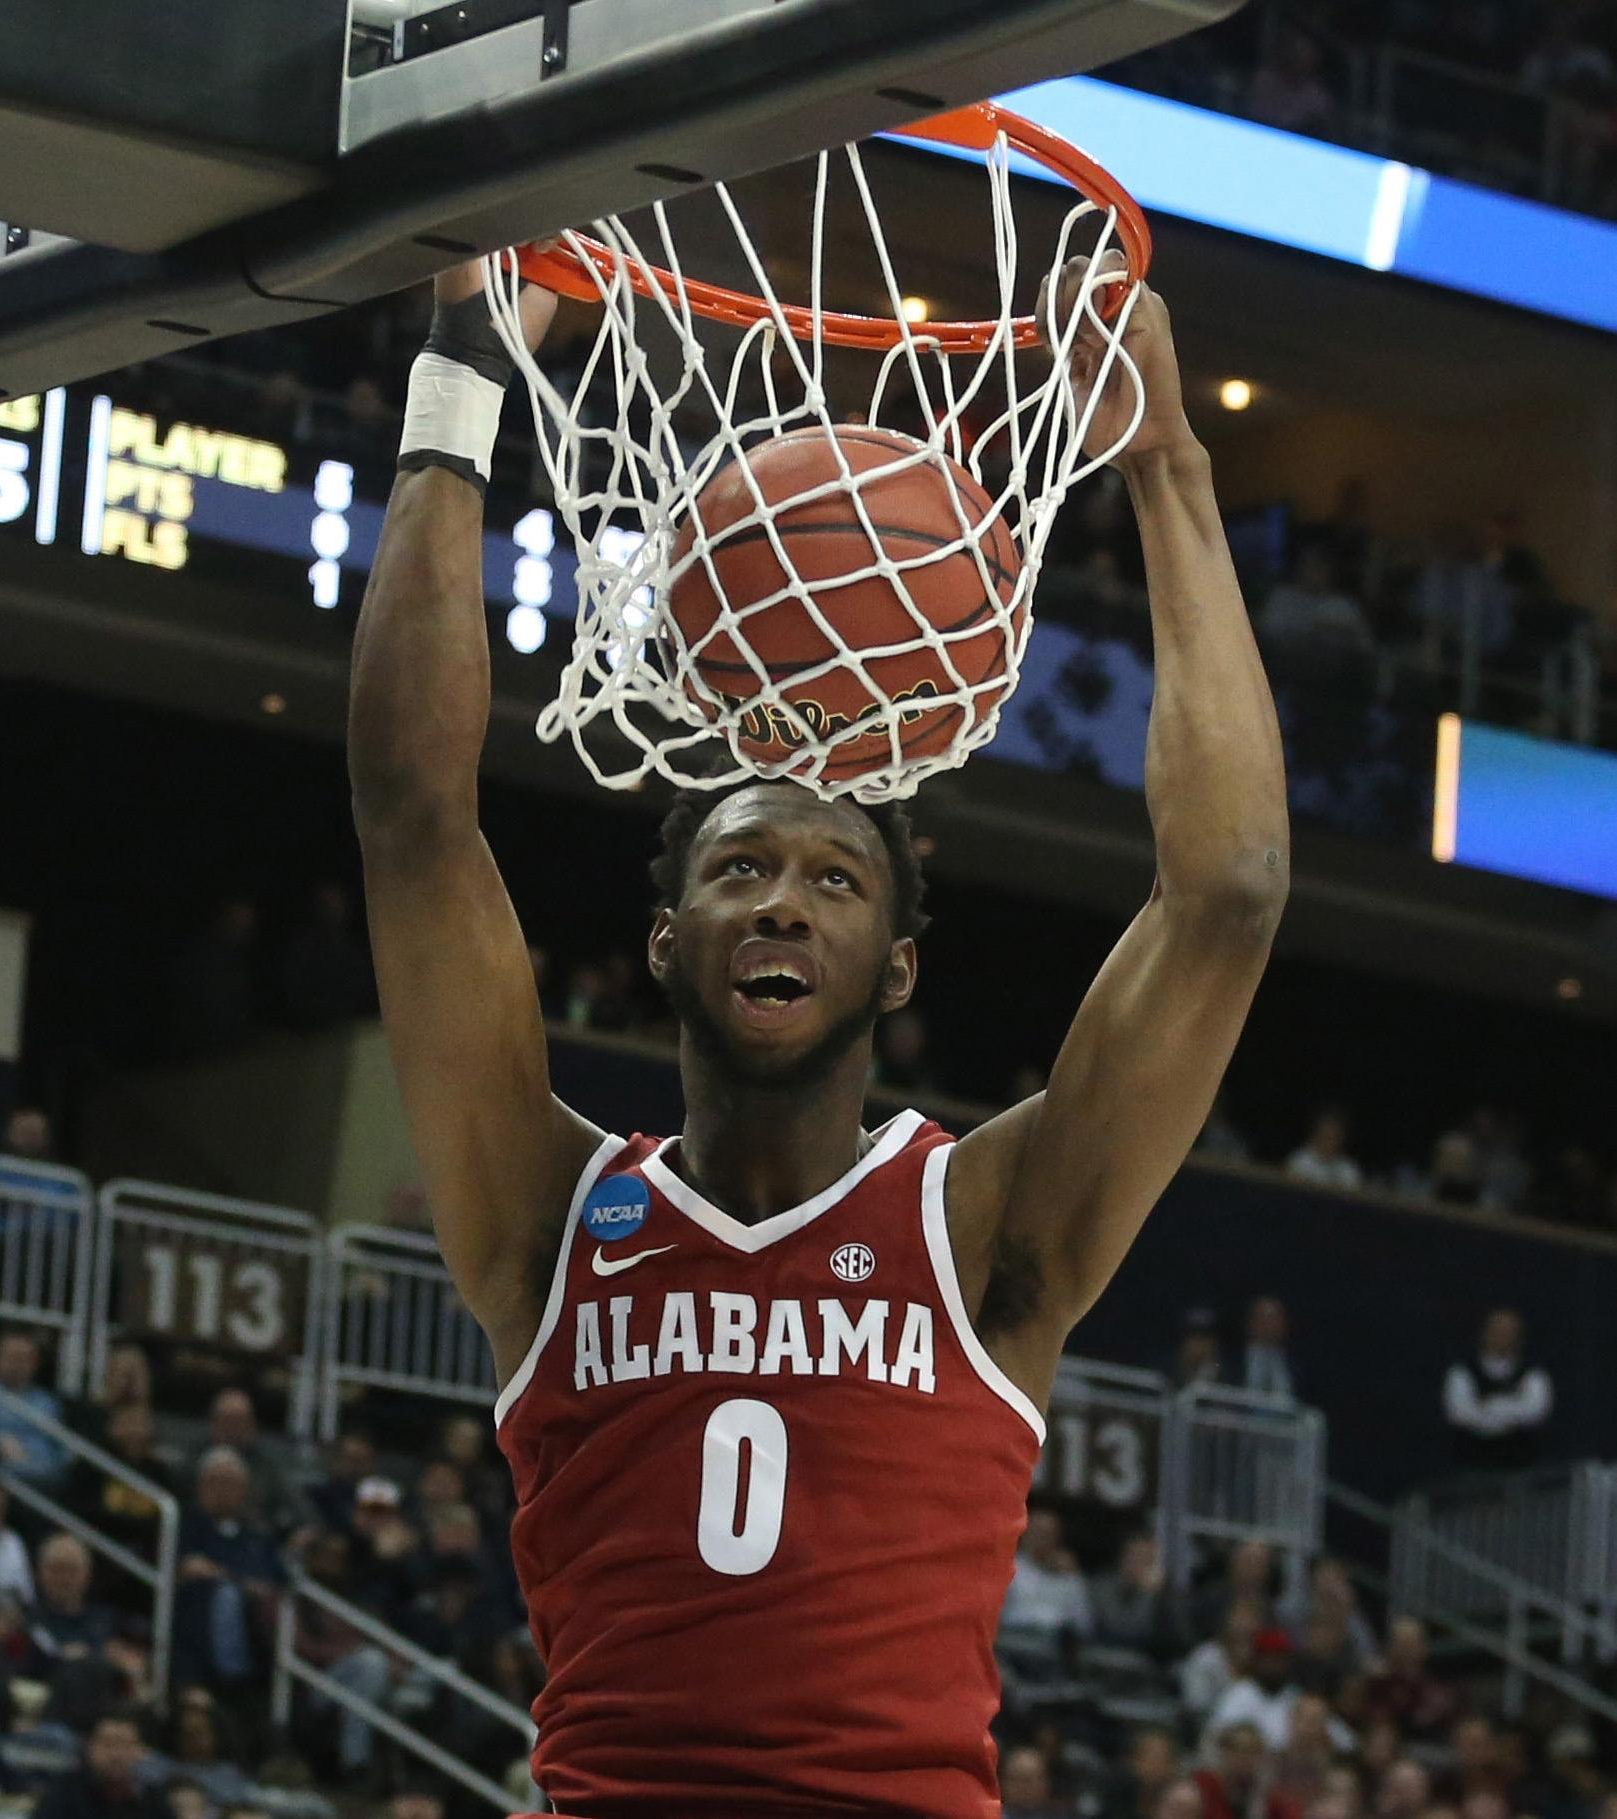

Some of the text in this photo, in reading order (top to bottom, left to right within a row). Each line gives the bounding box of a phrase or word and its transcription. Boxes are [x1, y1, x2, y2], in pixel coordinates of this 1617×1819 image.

[105, 458, 194, 522] PTS
[108, 407, 287, 493] PLAYER
[98, 507, 190, 570] FLS
[590, 1204, 646, 1224] NCAA
[143, 1247, 282, 1350] 113
[835, 1247, 871, 1278] SEC
[573, 1292, 936, 1394] ALABAMA
[696, 1399, 788, 1576] 0
[1034, 1416, 1146, 1506] 13
